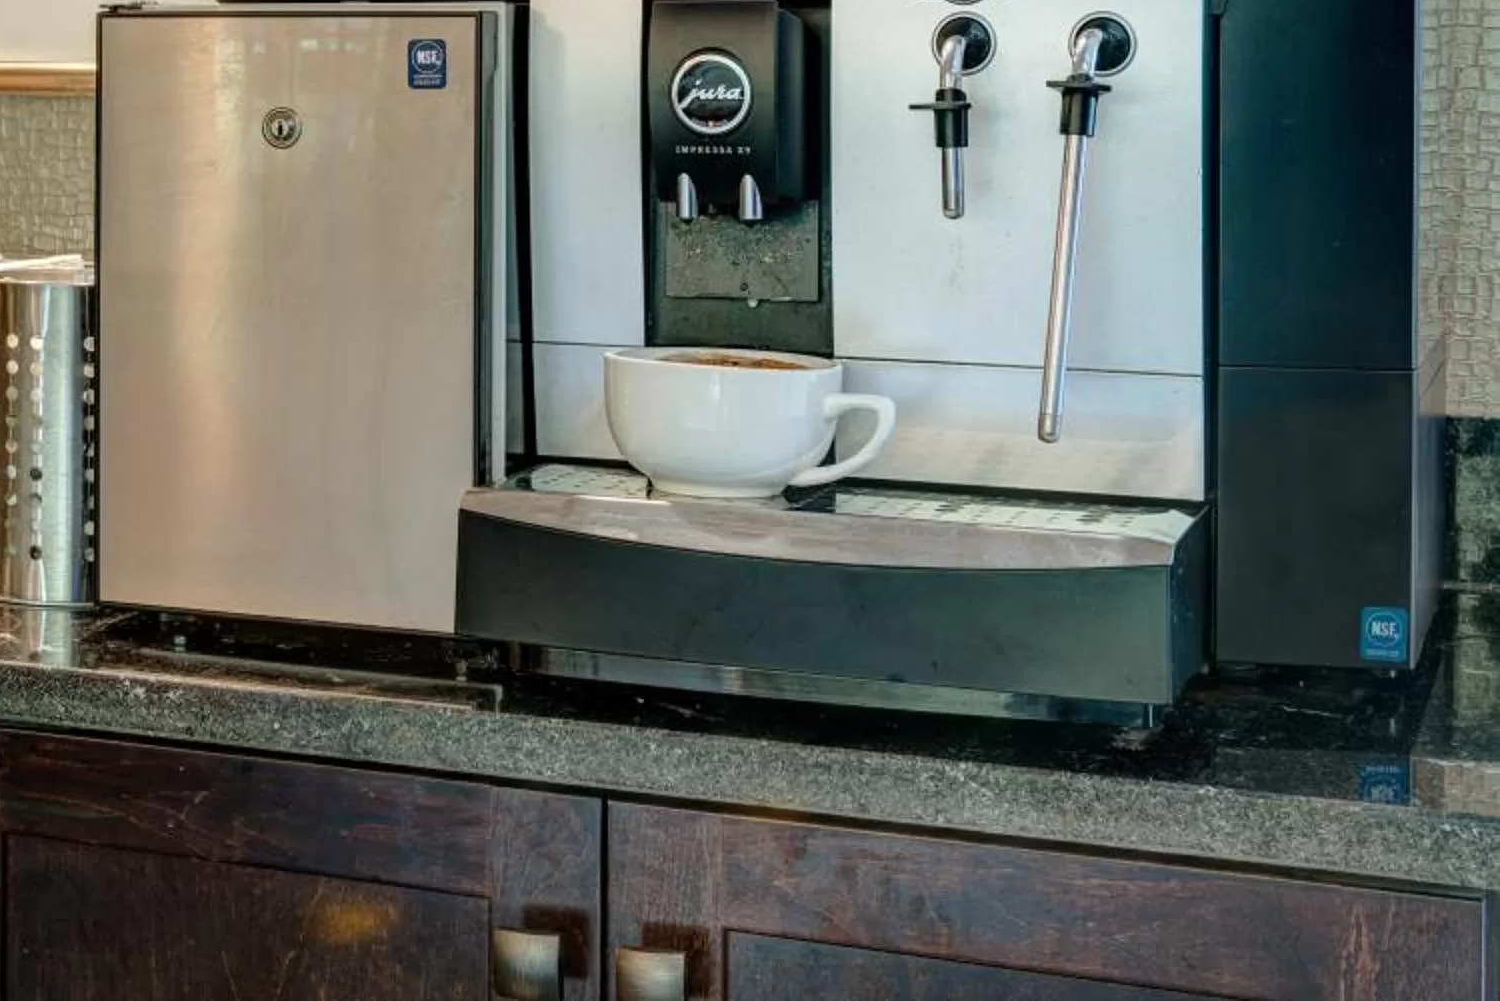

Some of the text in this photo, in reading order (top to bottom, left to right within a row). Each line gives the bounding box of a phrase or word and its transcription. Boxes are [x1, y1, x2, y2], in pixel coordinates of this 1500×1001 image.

[679, 80, 745, 110] jura
[675, 145, 733, 155] IMPRESSA
[1371, 621, 1397, 637] NSF
